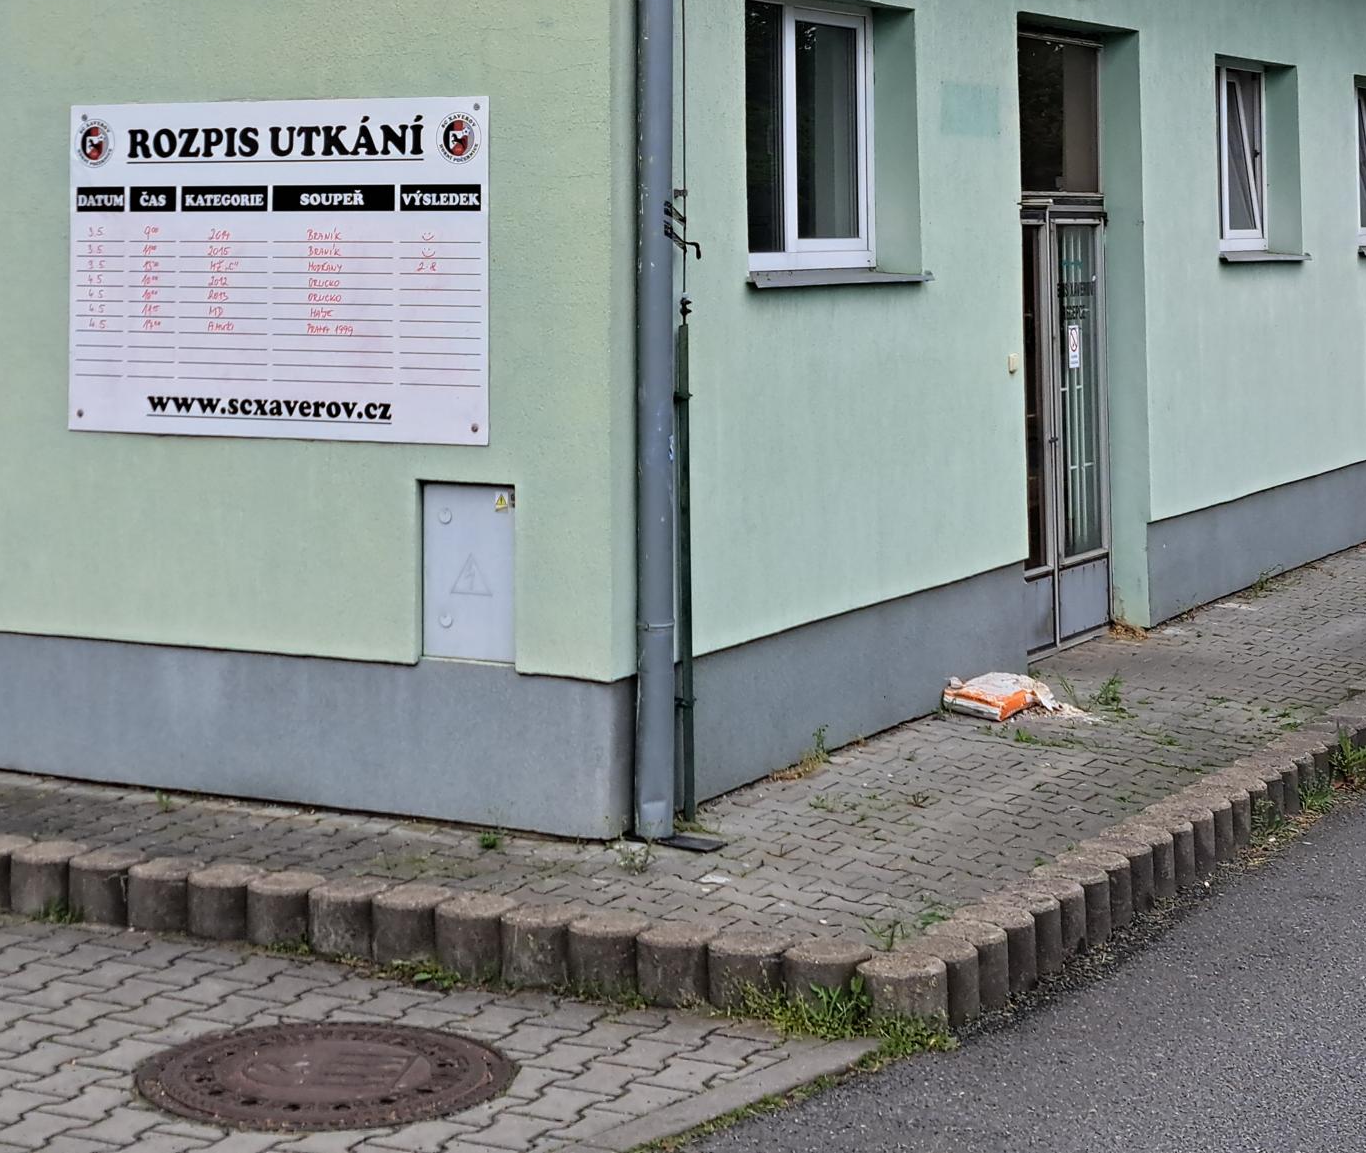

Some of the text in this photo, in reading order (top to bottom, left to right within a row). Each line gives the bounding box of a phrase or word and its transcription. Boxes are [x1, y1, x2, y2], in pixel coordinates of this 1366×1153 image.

[127, 126, 260, 159] ROZPIS
[269, 115, 424, 157] UTKÁNÍ
[78, 190, 480, 206] DATUM ČAS KATEGORIE SOUPEŘ VÝSLEDEK
[147, 396, 392, 420] www.scxaverov.cz
